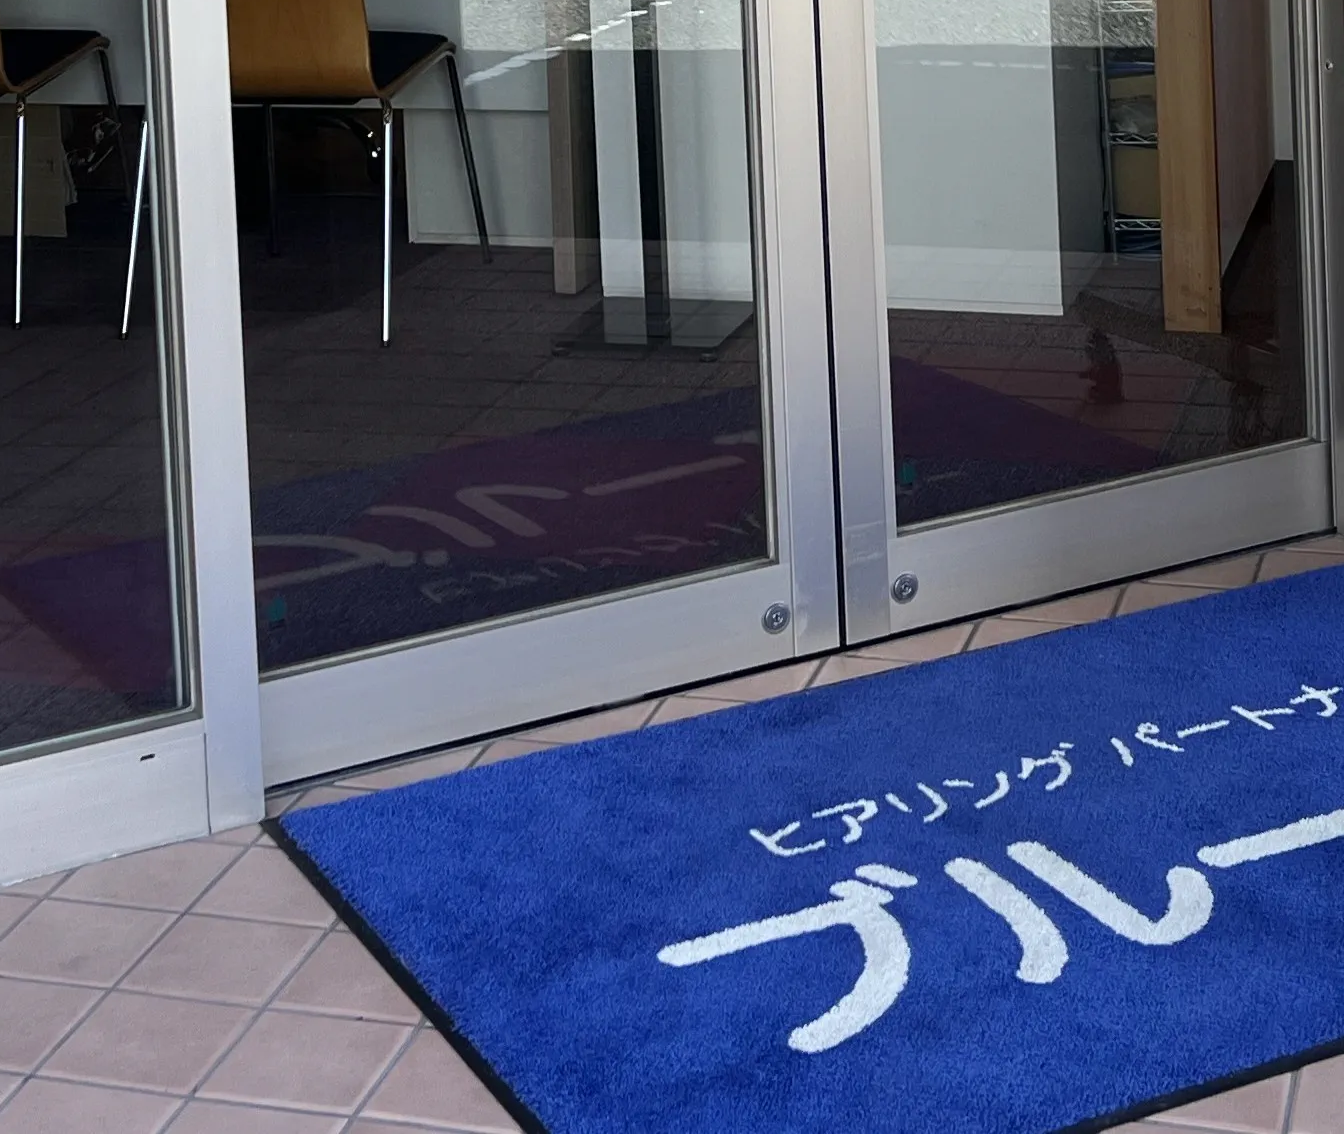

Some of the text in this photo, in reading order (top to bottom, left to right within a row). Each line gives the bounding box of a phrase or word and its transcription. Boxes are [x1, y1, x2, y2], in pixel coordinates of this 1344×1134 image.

[751, 738, 1075, 858] ヒアリング
